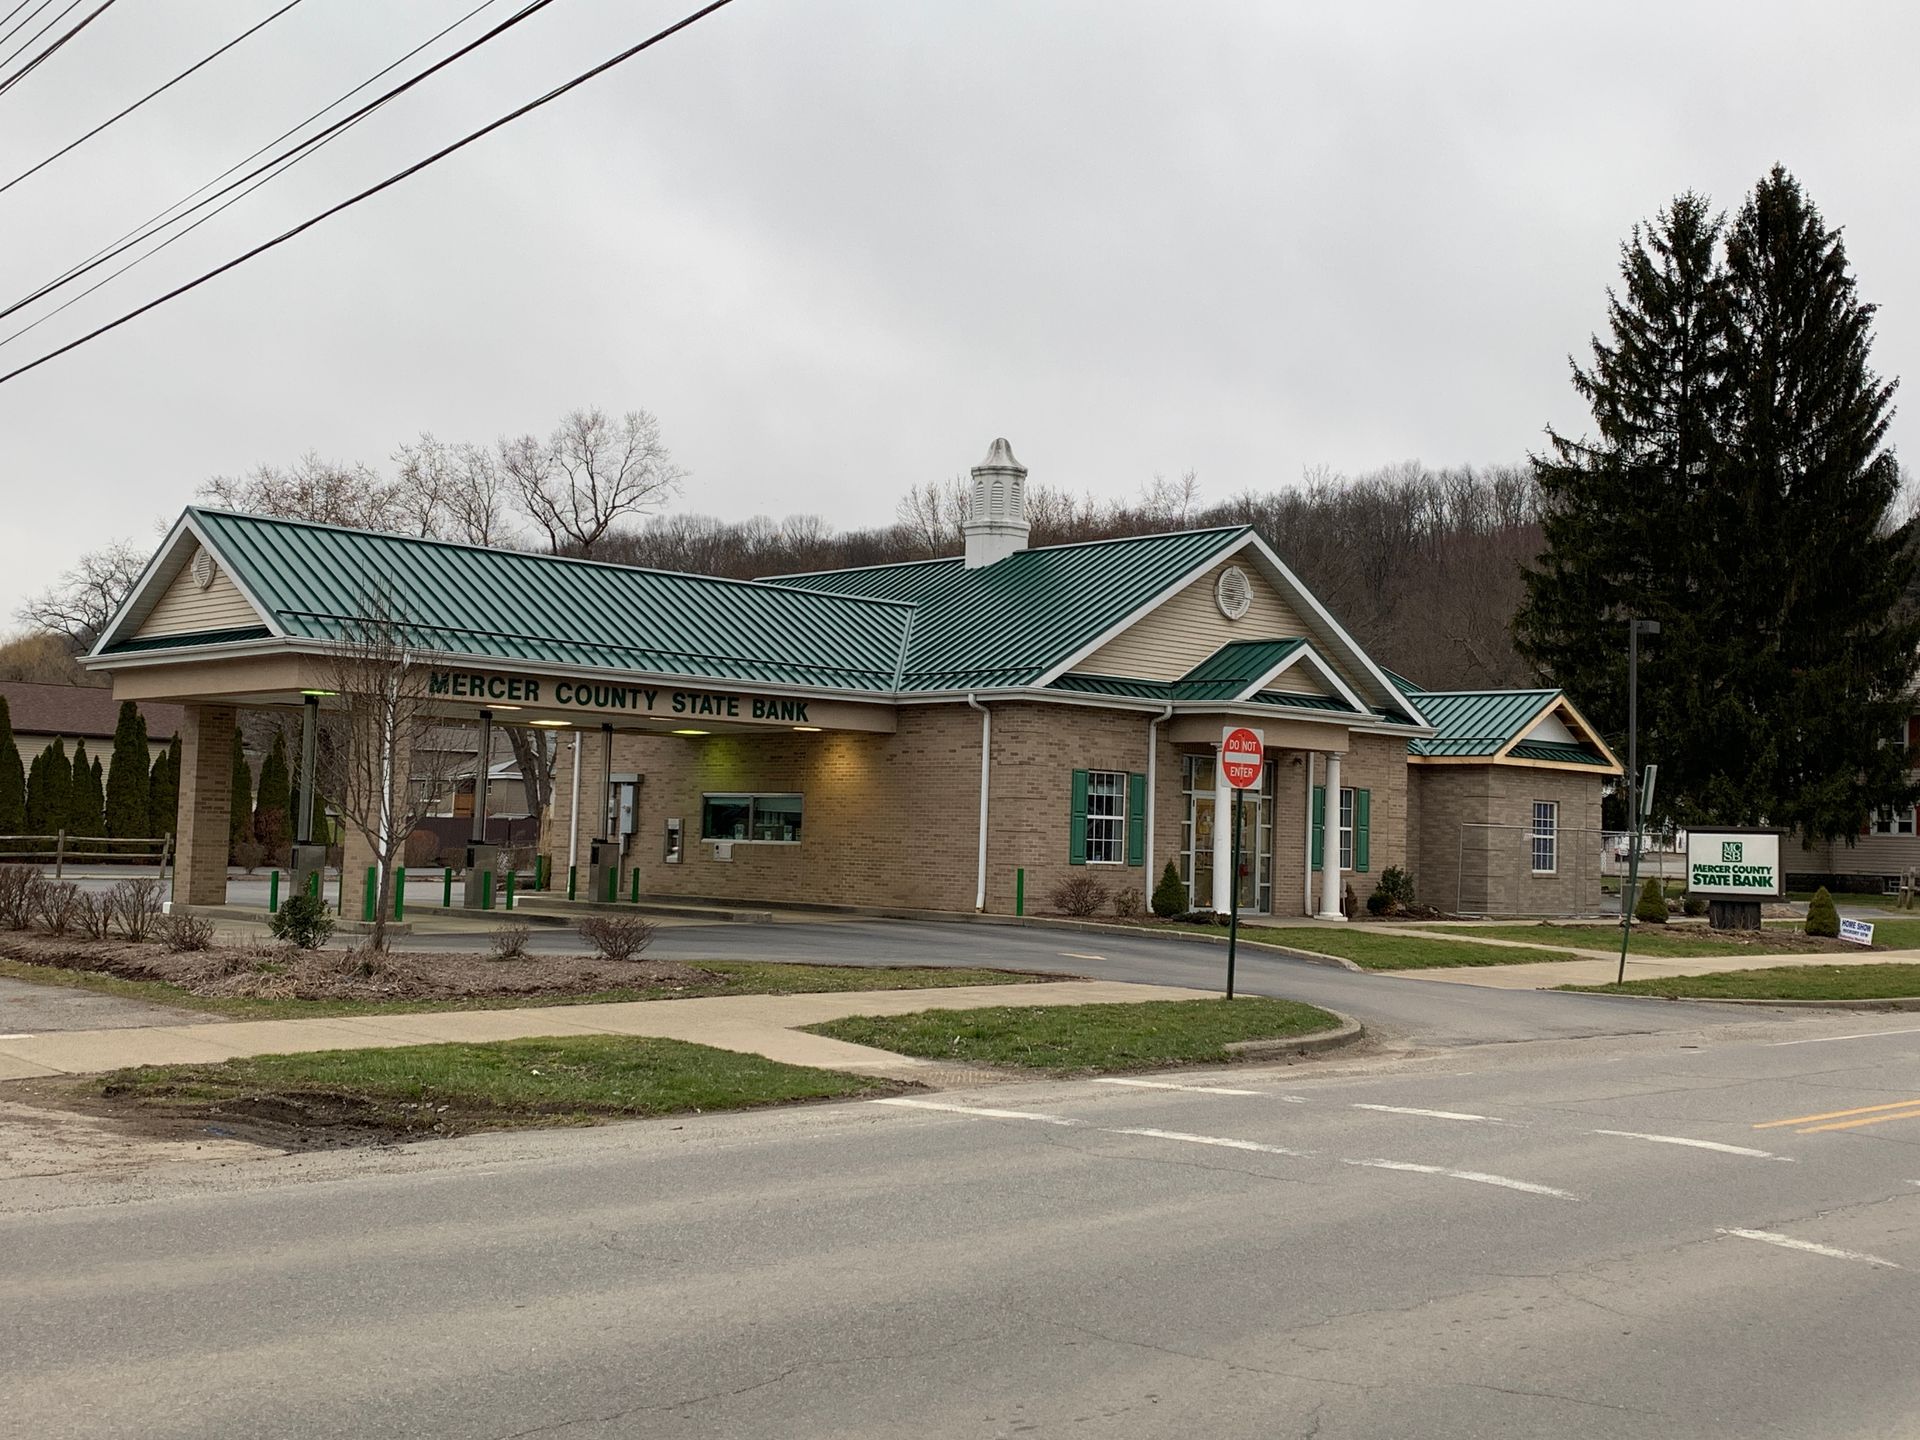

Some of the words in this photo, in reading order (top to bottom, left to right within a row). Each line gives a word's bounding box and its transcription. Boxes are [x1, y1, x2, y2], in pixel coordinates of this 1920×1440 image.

[429, 672, 540, 701] MERCER
[556, 682, 658, 710] COUNTY
[672, 693, 740, 717] STATE
[752, 699, 809, 722] BANK
[1229, 740, 1240, 750] DO
[1241, 741, 1257, 752] NOT
[1230, 767, 1253, 778] ENTER
[1723, 842, 1741, 852] MC
[1723, 852, 1741, 861] SB
[1692, 864, 1731, 874] MERCER
[1732, 865, 1772, 875] COUNTY
[1692, 874, 1730, 886] STATE
[1732, 876, 1774, 888] BANK
